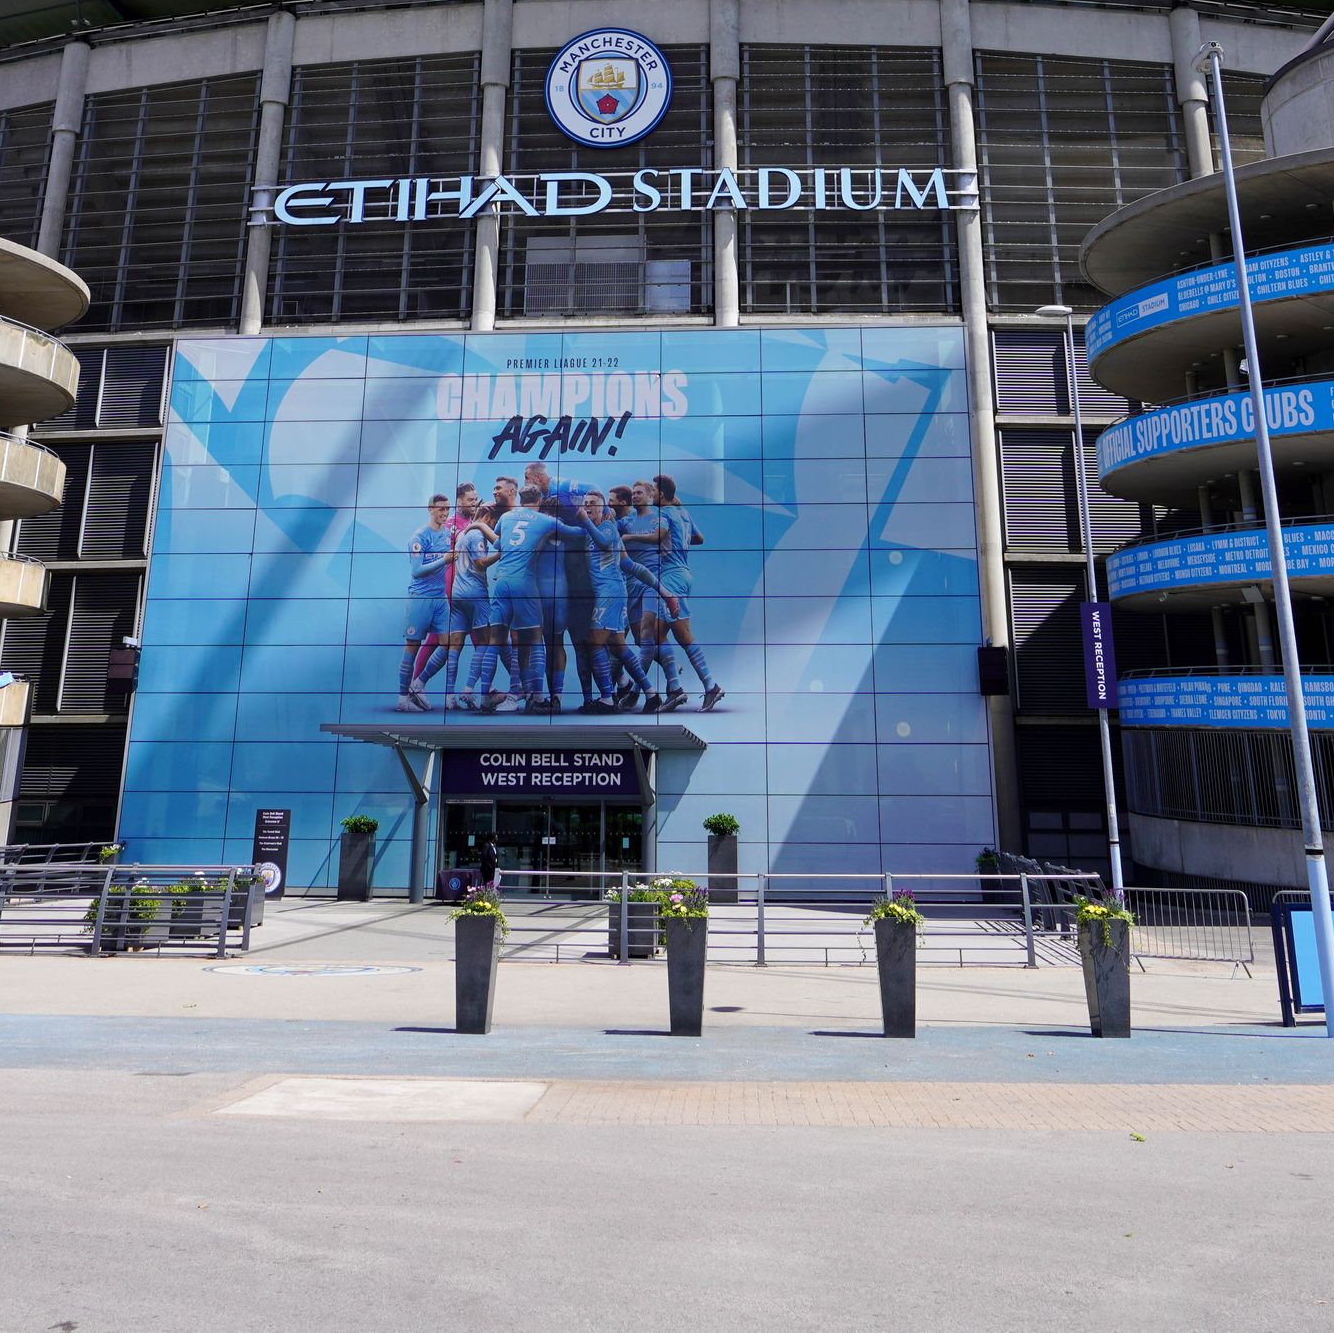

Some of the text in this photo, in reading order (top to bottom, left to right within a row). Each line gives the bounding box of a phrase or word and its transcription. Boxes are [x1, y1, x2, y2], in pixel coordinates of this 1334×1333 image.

[560, 37, 658, 73] MANCHESTER
[590, 127, 625, 138] CITY
[273, 167, 951, 226] ETIHAD STADIUM
[1300, 251, 1323, 262] ASTLEY
[1275, 268, 1300, 279] BOSTON
[507, 359, 549, 368] PREMIER
[592, 358, 618, 367] 21-22
[435, 370, 689, 423] CHAMPIONS
[487, 410, 633, 460] AGAIN!
[1103, 389, 1315, 469] OFFICIAL SUPPORTERS CUBS
[509, 521, 529, 546] 5
[1302, 544, 1328, 555] MEXICO
[1091, 610, 1107, 700] WEST RECEPTION
[480, 753, 624, 766] COLIN BELL STAND
[481, 773, 621, 786] WEST RECEPTION
